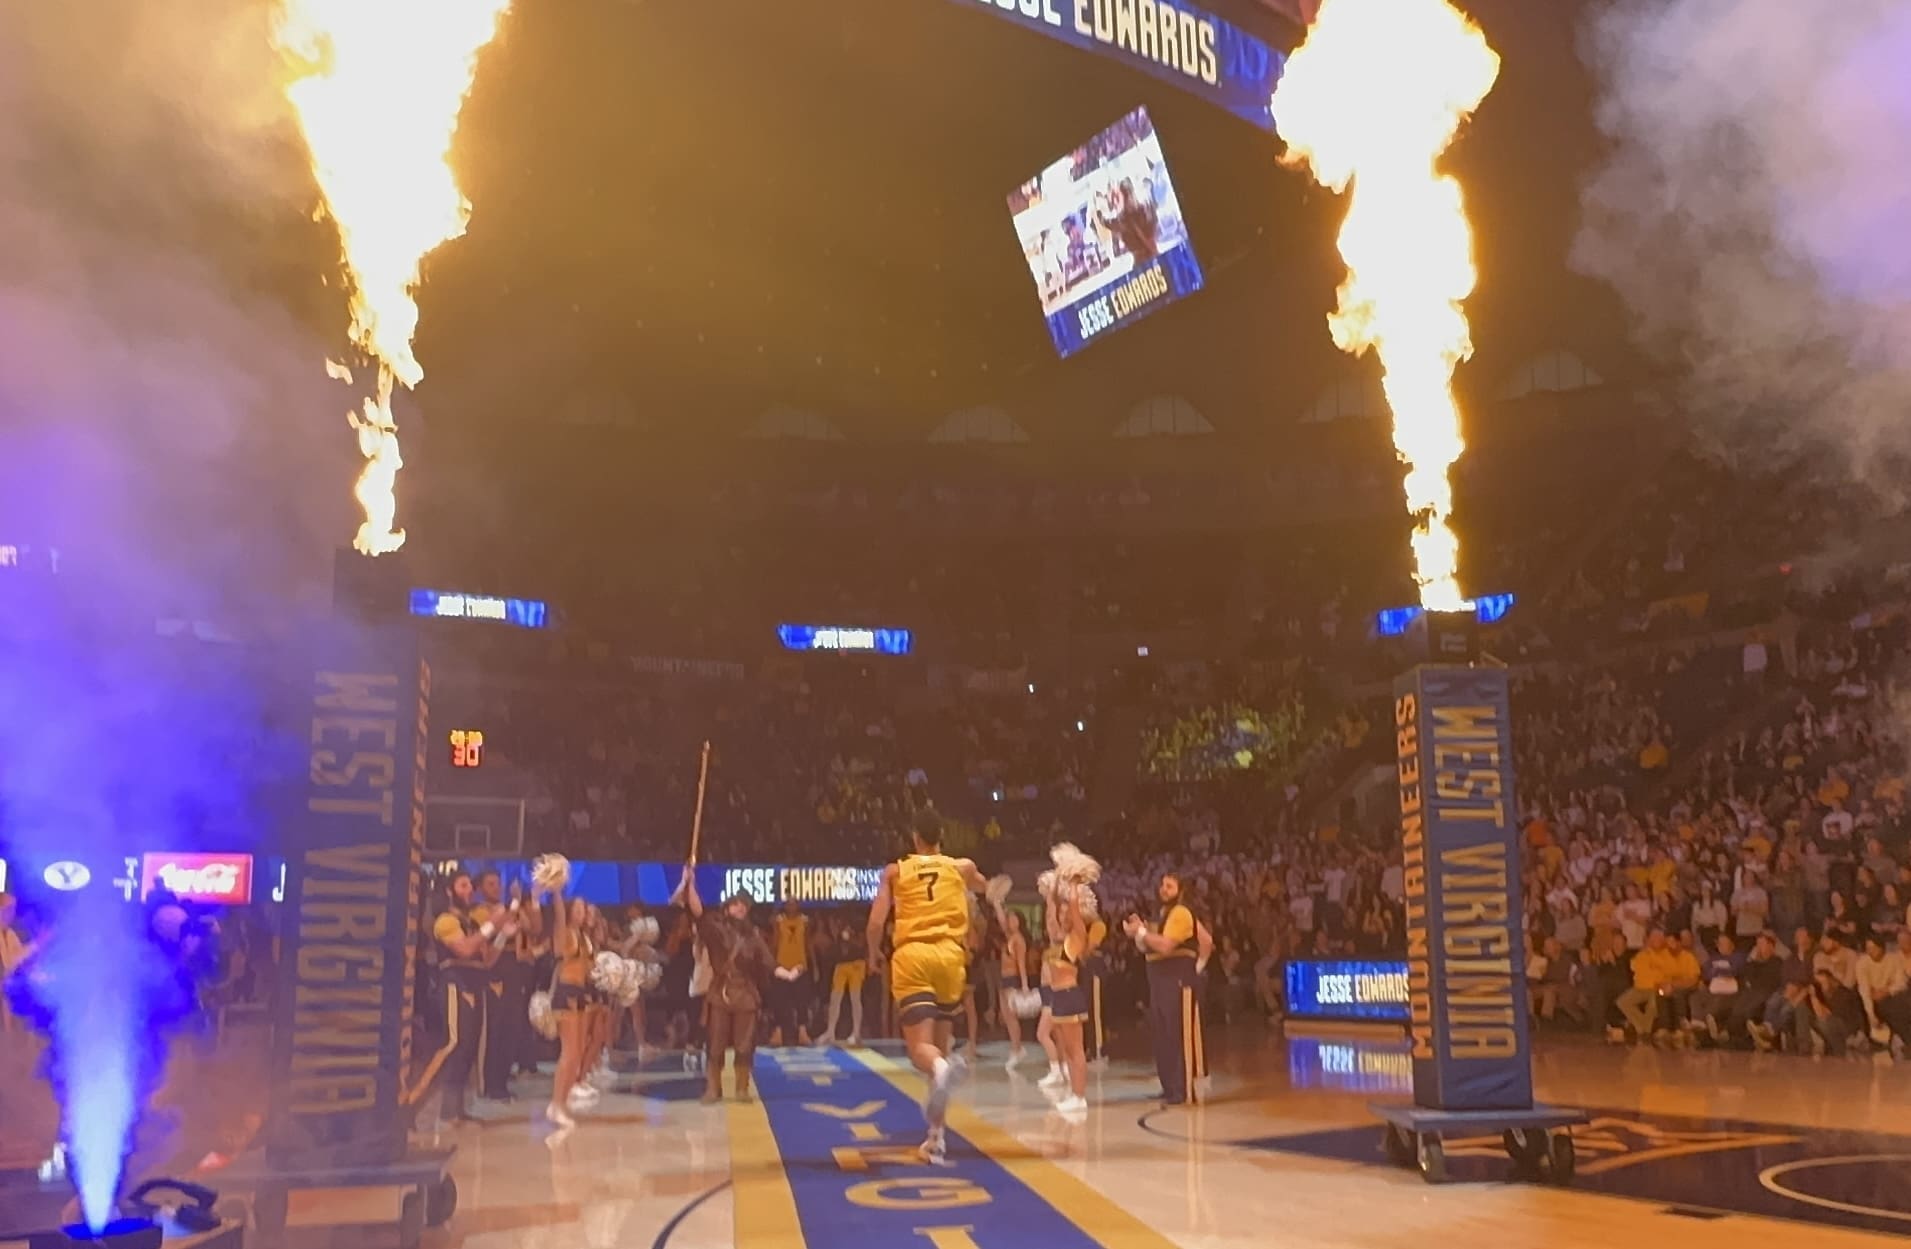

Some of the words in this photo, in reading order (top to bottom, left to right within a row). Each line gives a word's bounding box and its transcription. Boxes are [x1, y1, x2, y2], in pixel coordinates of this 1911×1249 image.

[1079, 295, 1114, 339] JESSE
[1110, 263, 1168, 319] EDWARDS
[308, 671, 398, 826] WEST
[1432, 706, 1505, 828] WEST
[720, 868, 774, 902] JESSE
[917, 871, 939, 901] 7
[1395, 692, 1434, 1059] MOUNTAINEERS
[289, 843, 391, 1113] VIRGINIA
[1316, 974, 1353, 1003] JESSE
[1354, 972, 1409, 1003] EDWARDS
[1441, 842, 1518, 1060] VIRGINIA
